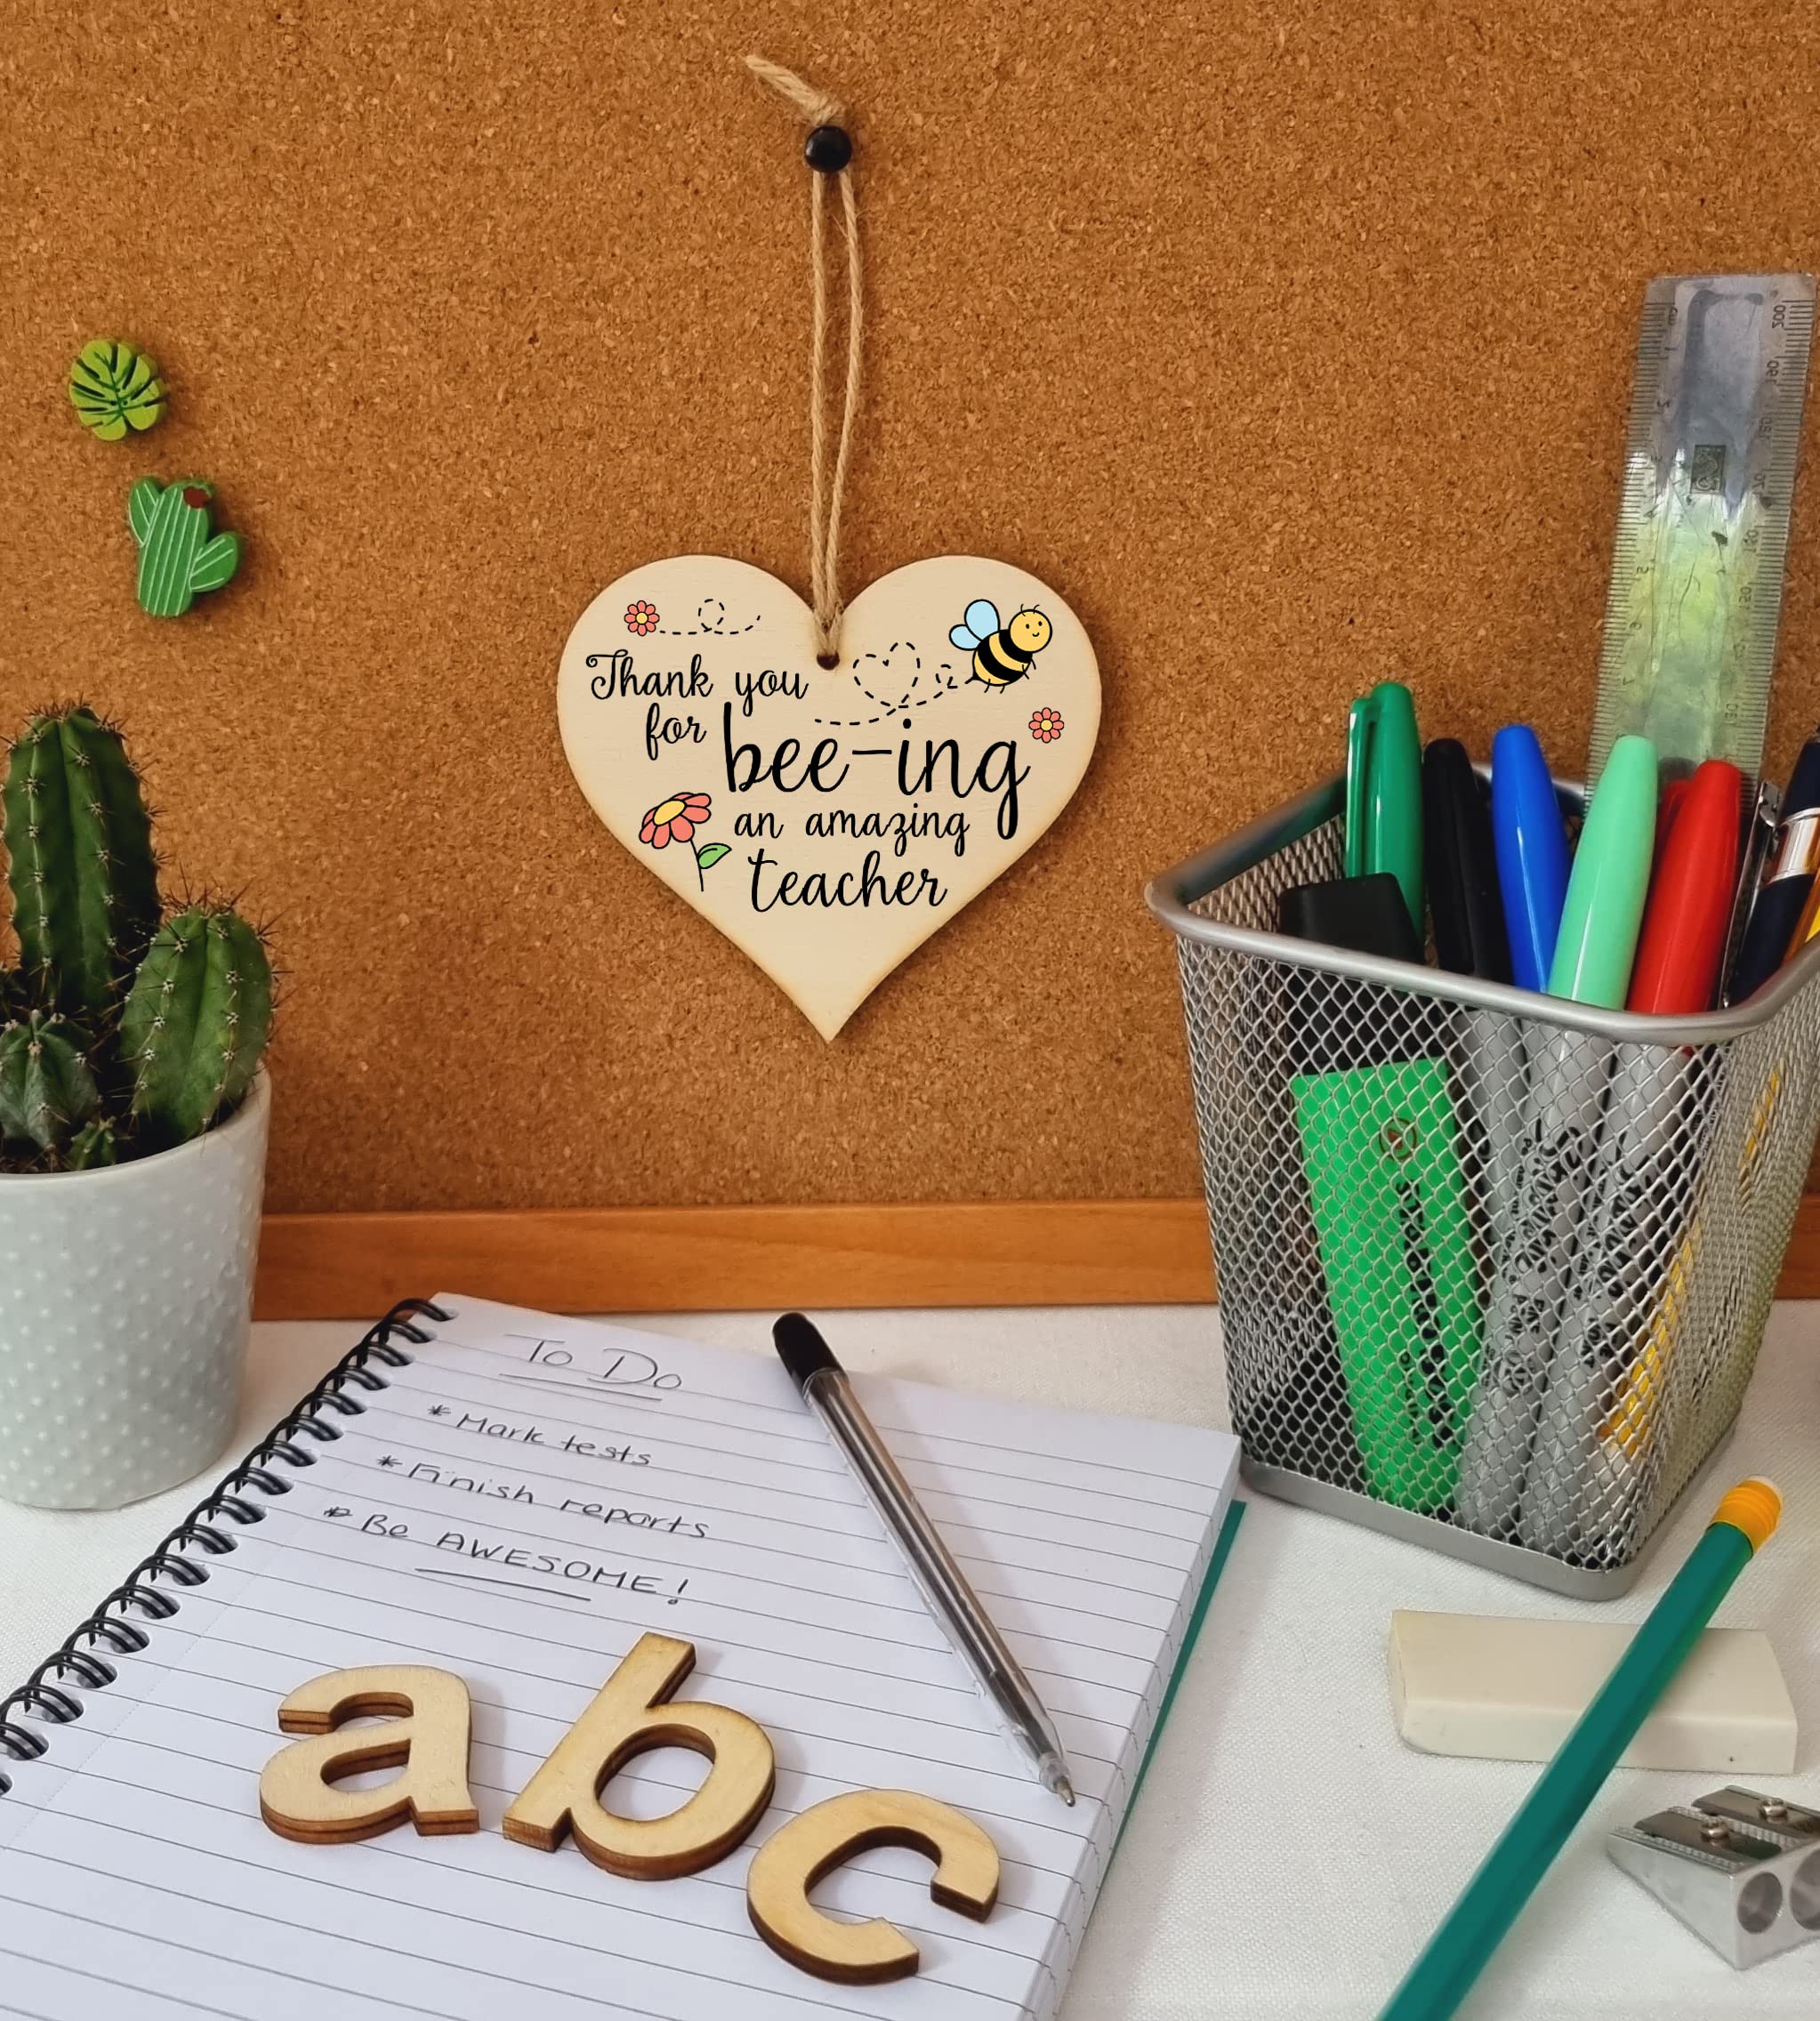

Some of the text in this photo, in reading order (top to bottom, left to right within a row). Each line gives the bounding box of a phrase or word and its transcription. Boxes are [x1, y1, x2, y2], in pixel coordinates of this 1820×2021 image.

[585, 649, 809, 717] Thank you
[646, 701, 1031, 841] for bee-ing
[734, 803, 970, 857] an amazing
[748, 849, 948, 913] teacher
[504, 1333, 683, 1389] To Do
[455, 1413, 652, 1467] Mark tests
[359, 1514, 409, 1538] Be
[407, 1462, 710, 1539] Finish reports
